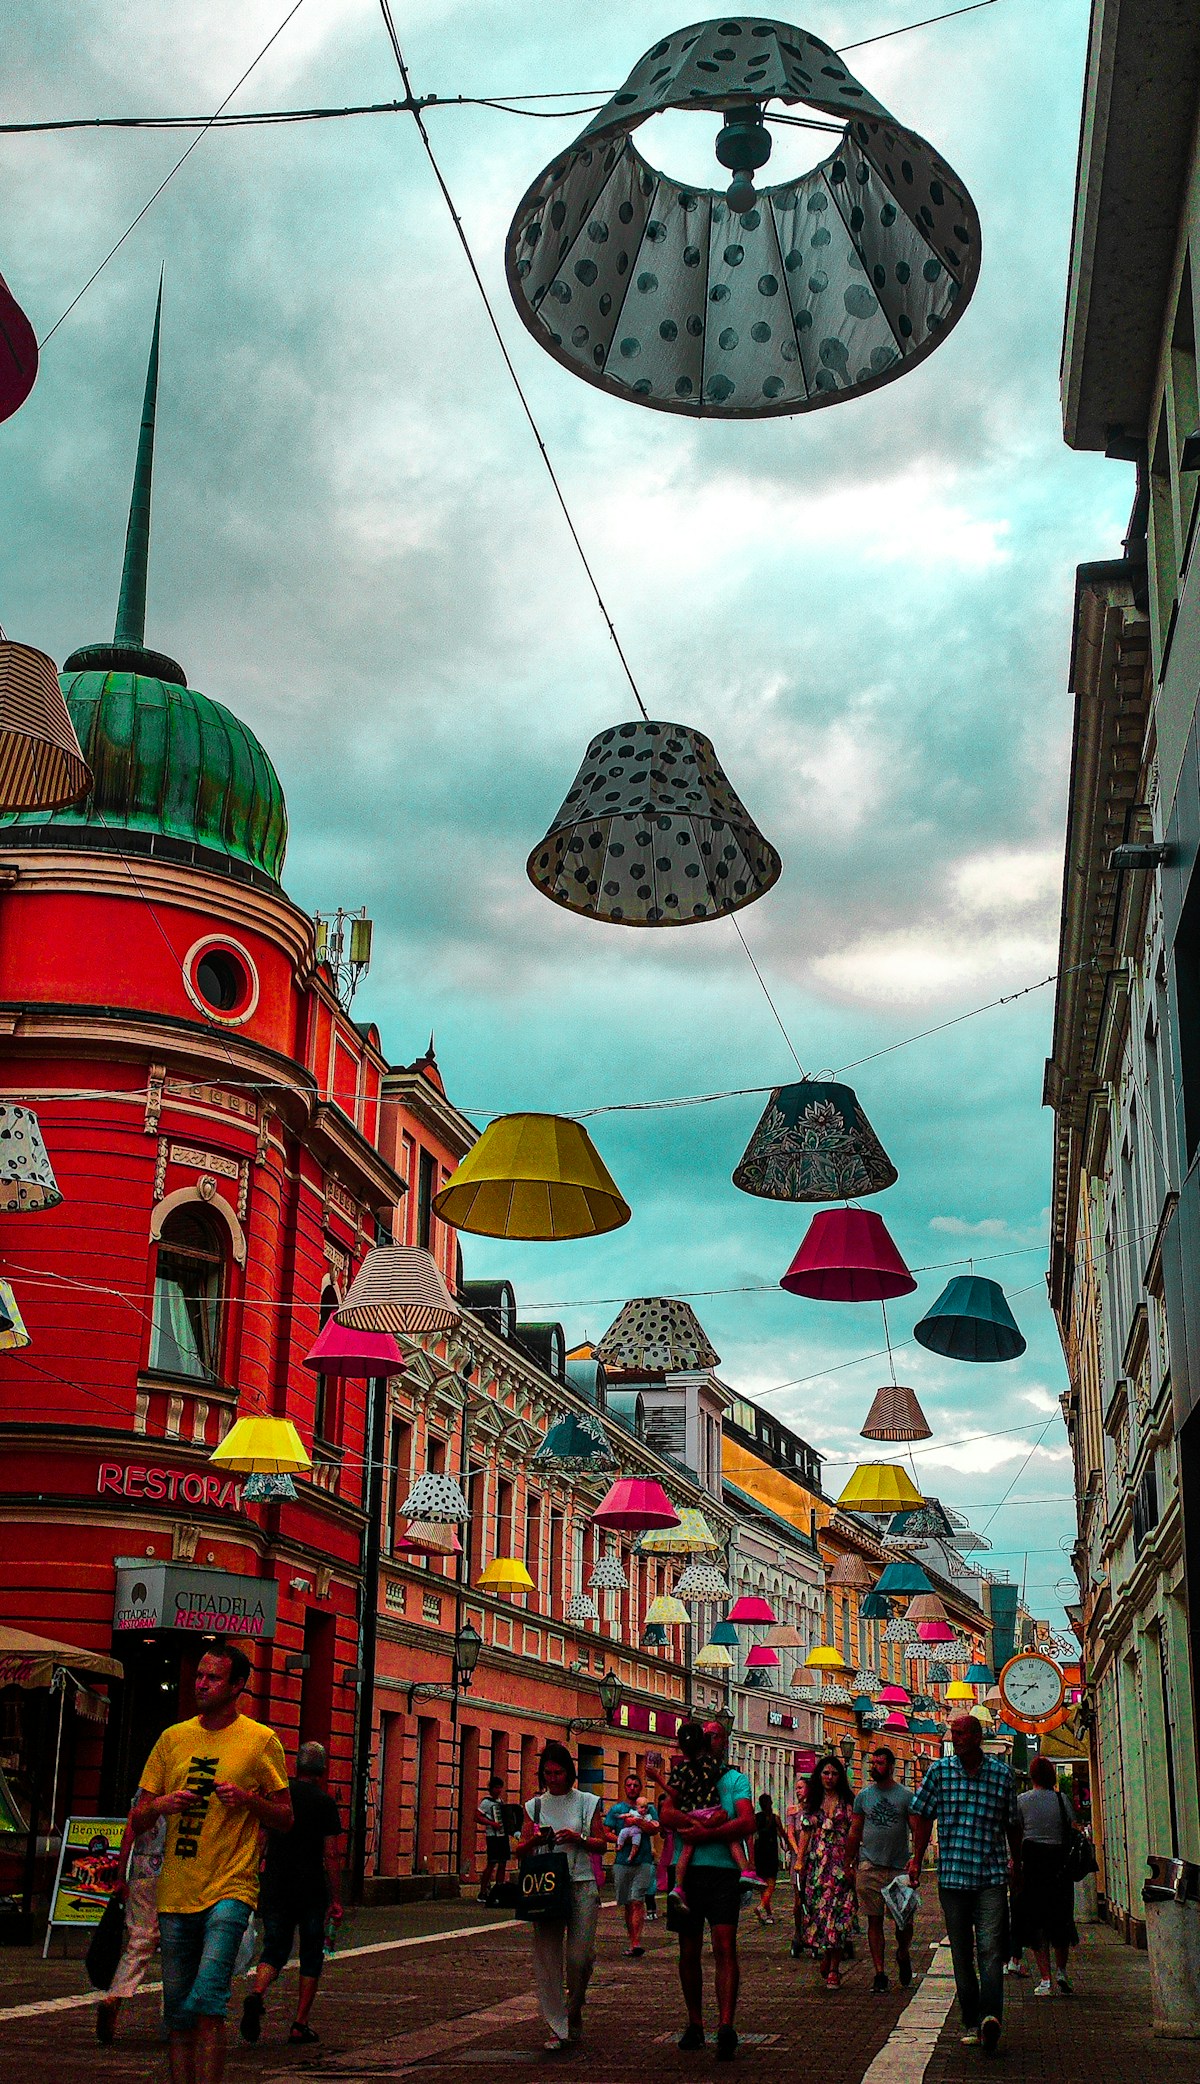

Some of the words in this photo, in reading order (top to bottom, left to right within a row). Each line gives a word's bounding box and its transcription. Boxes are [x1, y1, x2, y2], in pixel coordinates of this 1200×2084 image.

[117, 1608, 158, 1620] CITADELA
[174, 1591, 266, 1619] CITADELA
[117, 1618, 157, 1630] RESTORAN
[173, 1609, 265, 1634] RESTORAN
[522, 1871, 556, 1894] OVS
